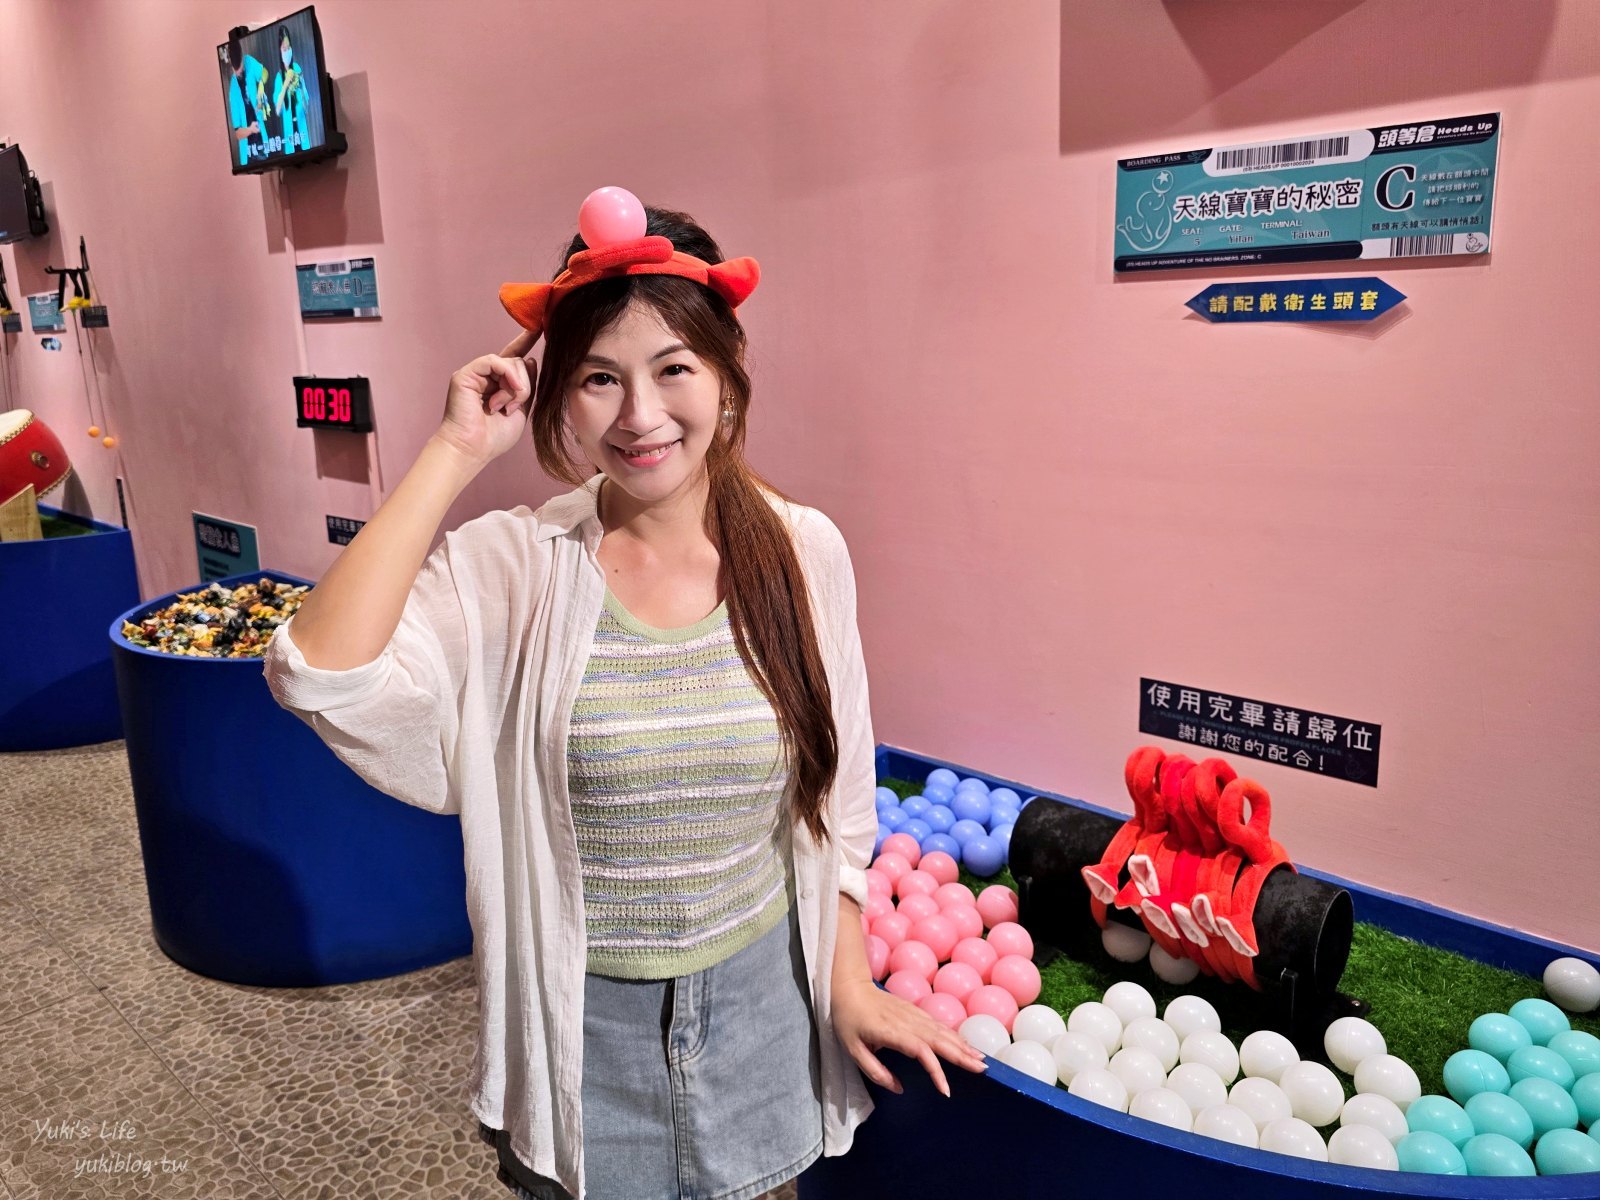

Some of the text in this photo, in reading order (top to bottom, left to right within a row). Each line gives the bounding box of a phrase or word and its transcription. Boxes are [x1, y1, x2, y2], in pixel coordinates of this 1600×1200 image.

[1437, 122, 1493, 135] Heads Up
[1126, 155, 1181, 167] BOARDING PASS
[1174, 179, 1362, 221] 天線寶寶的秘密
[1374, 163, 1417, 212] C
[1291, 229, 1331, 240] Taiwan
[1208, 290, 1379, 314] 請配戴衛生頭套
[1147, 683, 1373, 752] 使用完畢請歸位
[1178, 722, 1325, 771] 謝謝您的配合!
